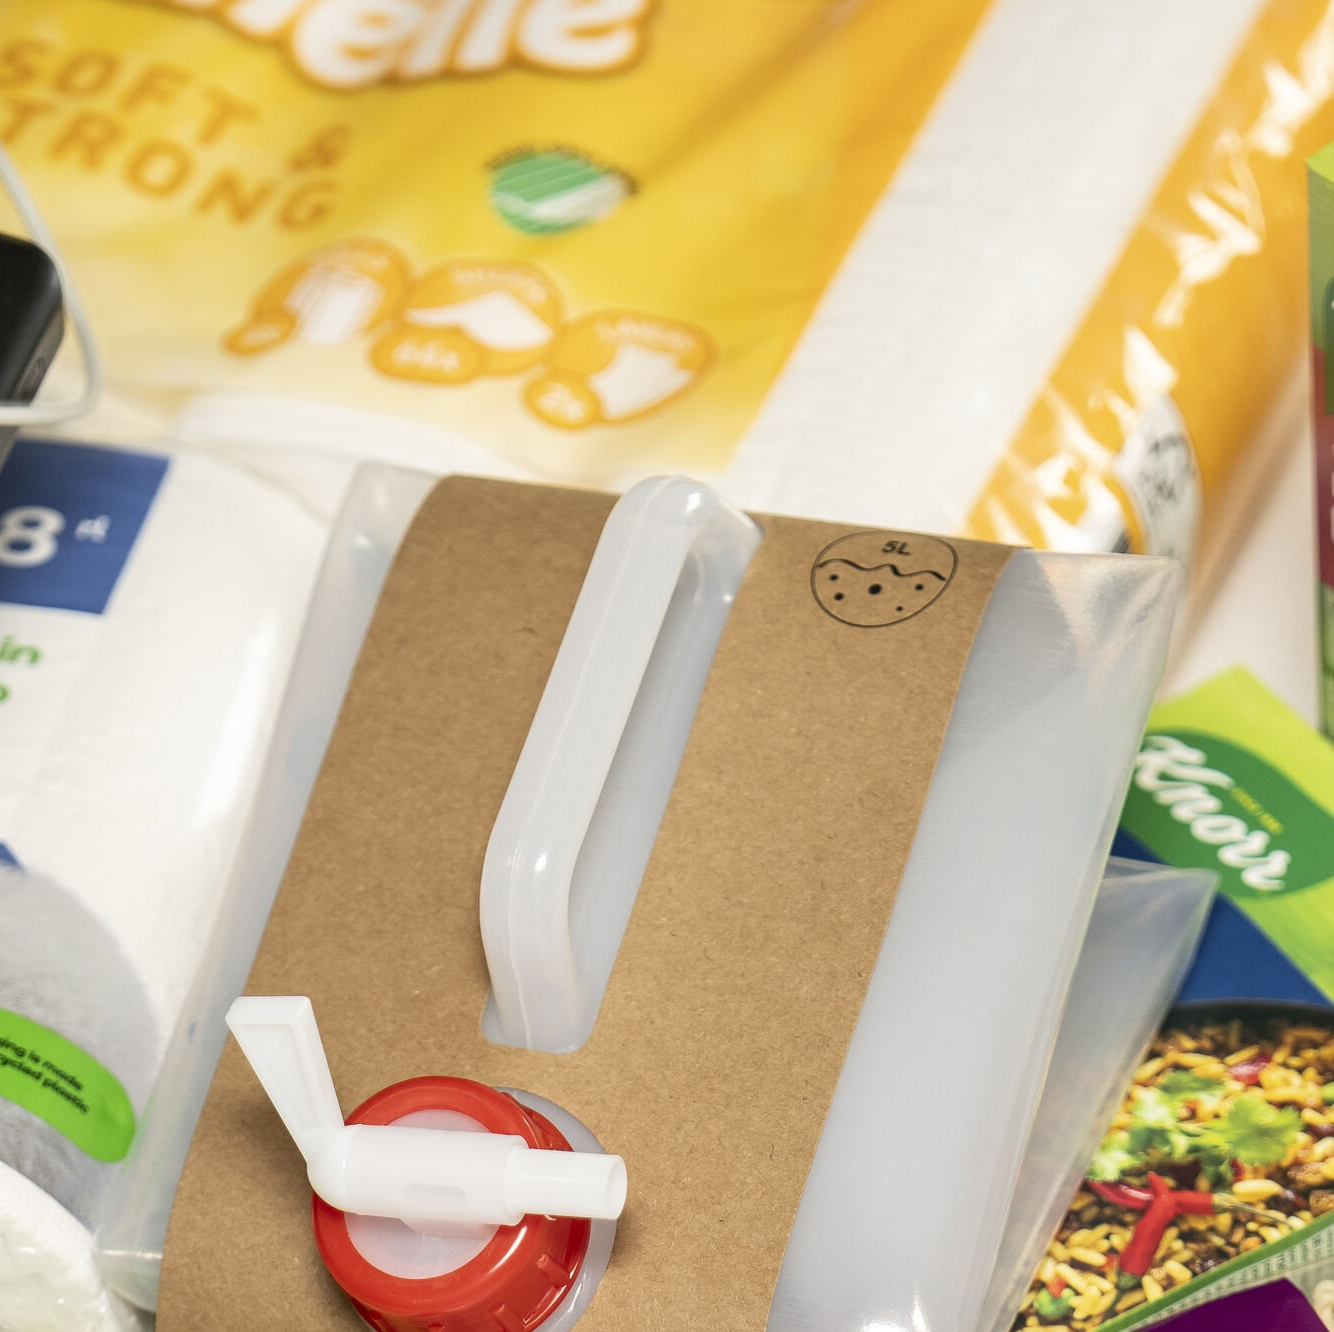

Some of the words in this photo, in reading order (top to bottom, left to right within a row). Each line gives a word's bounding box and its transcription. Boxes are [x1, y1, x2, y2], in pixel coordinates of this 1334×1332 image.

[882, 540, 911, 556] 5L
[1134, 735, 1291, 891] Knorr
[27, 1049, 42, 1065] is
[41, 1058, 84, 1093] made
[42, 1077, 90, 1115] plastic
